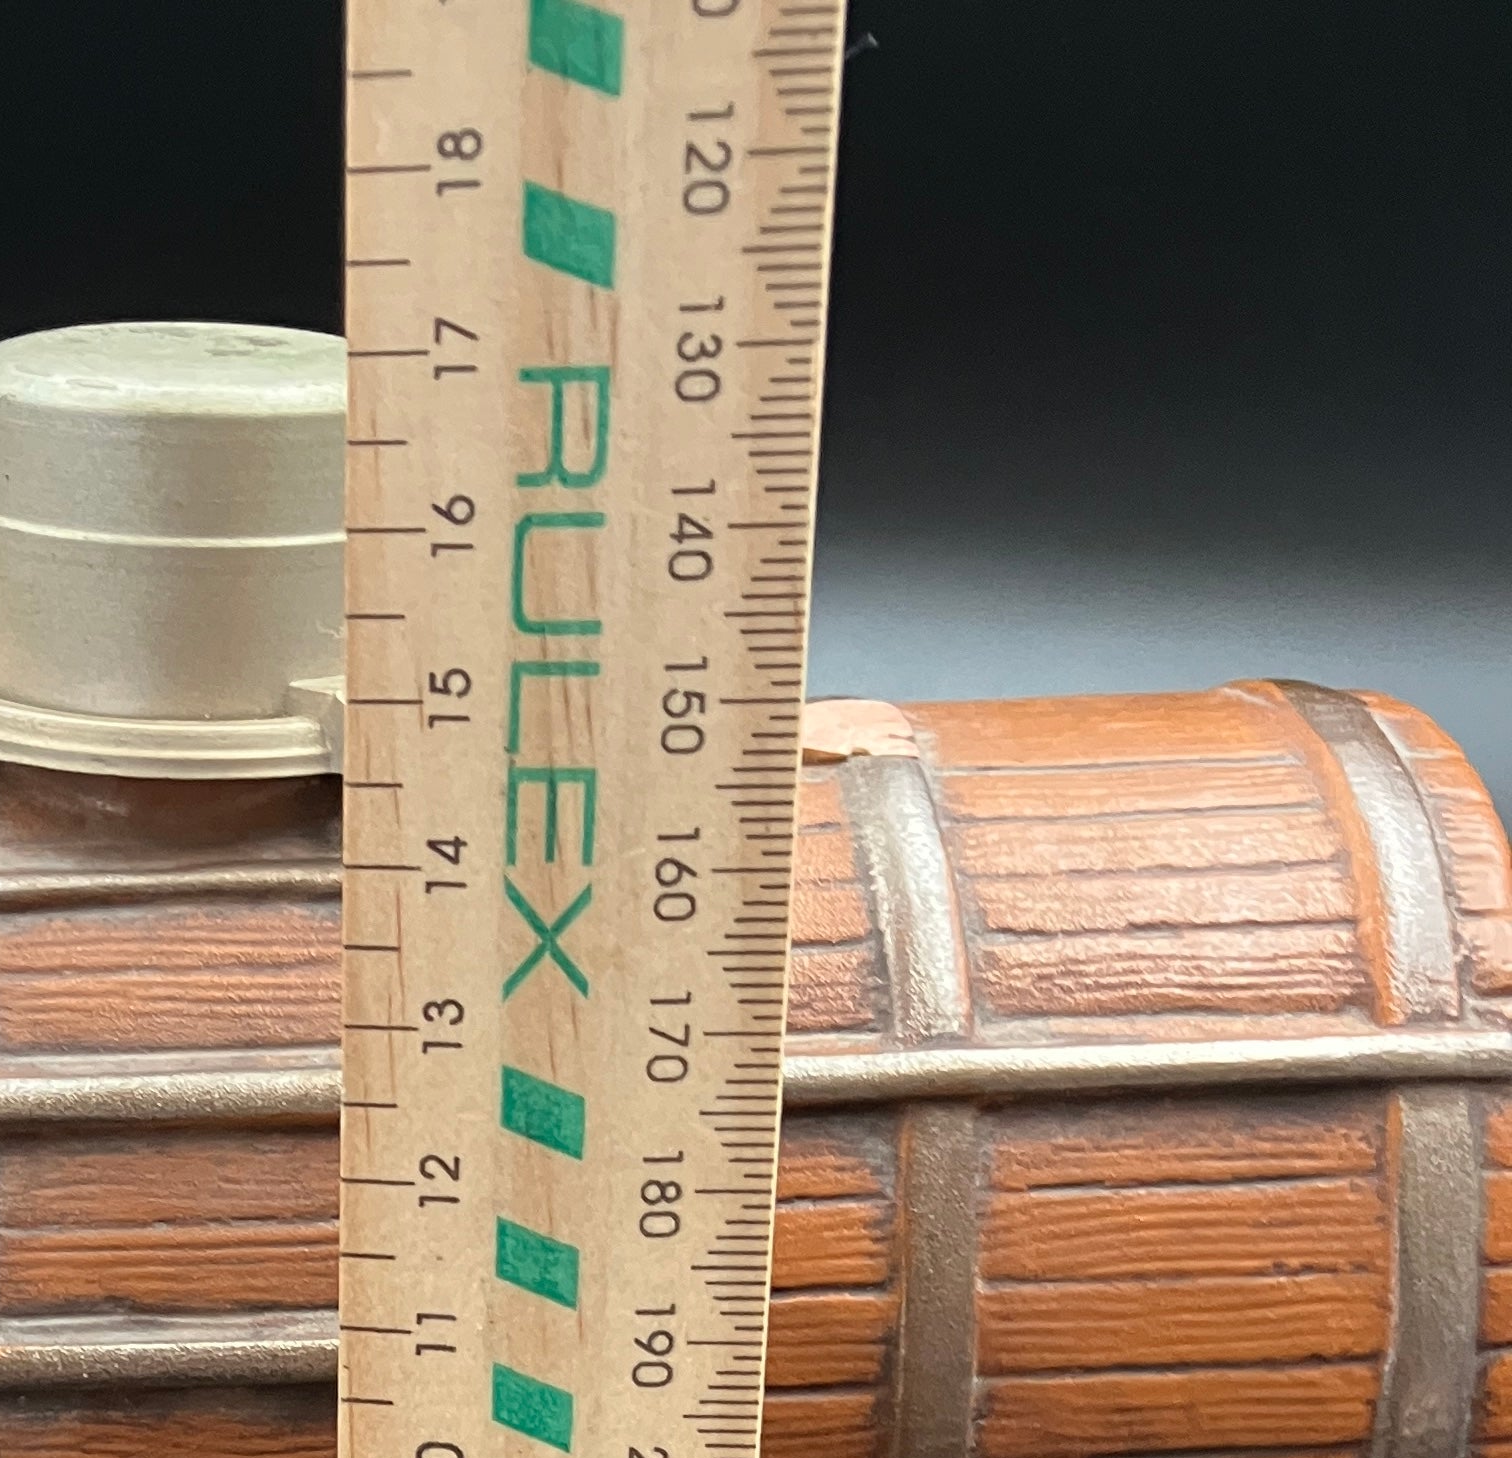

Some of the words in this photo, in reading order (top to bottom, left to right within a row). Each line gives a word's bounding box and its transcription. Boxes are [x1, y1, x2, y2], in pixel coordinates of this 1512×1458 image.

[437, 129, 484, 198] 18
[683, 105, 735, 217] 120
[434, 318, 480, 382] 17
[675, 297, 726, 404] 130
[431, 495, 477, 559] 16
[668, 480, 717, 583] 140
[427, 668, 473, 730] 15
[502, 364, 612, 1001] RULEX
[661, 655, 709, 756] 150
[425, 836, 469, 896] 14
[653, 828, 702, 923] 160
[422, 999, 466, 1056] 13
[646, 991, 693, 1084] 170
[419, 1155, 462, 1210] 12
[639, 1151, 685, 1240] 180
[414, 1313, 459, 1357] 11
[632, 1304, 678, 1389] 190
